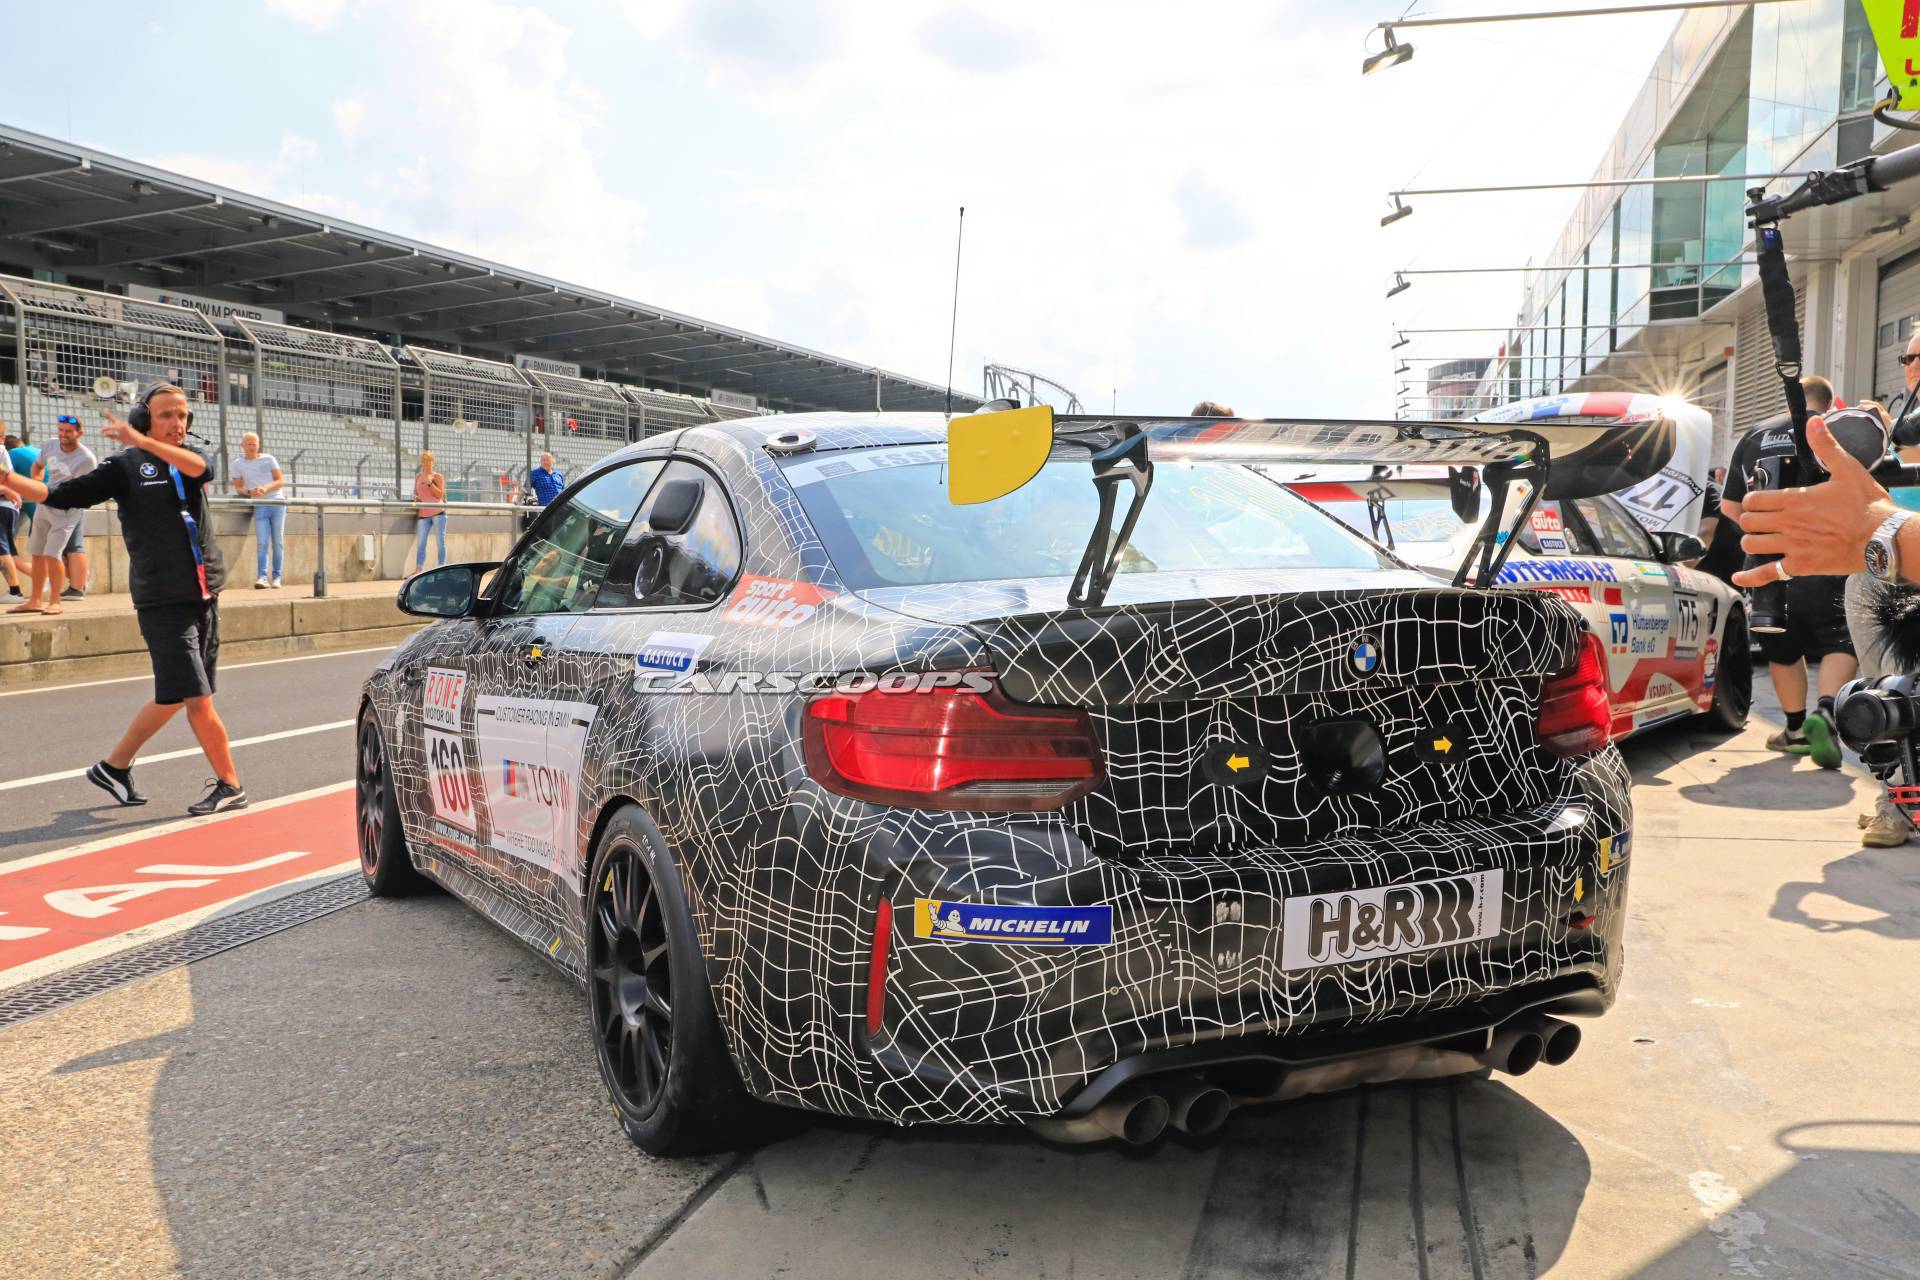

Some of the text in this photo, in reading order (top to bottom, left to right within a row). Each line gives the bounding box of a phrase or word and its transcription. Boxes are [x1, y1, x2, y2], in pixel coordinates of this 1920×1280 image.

[212, 305, 222, 318] M
[223, 307, 262, 321] POWER
[555, 365, 576, 377] POWER
[867, 449, 949, 468] ESSE
[744, 579, 793, 598] sport
[727, 596, 818, 628] auto
[1678, 598, 1699, 642] 175
[1631, 636, 1646, 654] Bank
[642, 648, 689, 668] BASTUCK
[425, 674, 463, 710] ROWE
[424, 706, 455, 725] MOTOR OIL
[430, 737, 470, 817] 160
[528, 763, 570, 812] TOWN
[1476, 873, 1486, 937] www.h-r.com
[968, 917, 1091, 934] MICHELIN
[1307, 886, 1425, 963] H&R
